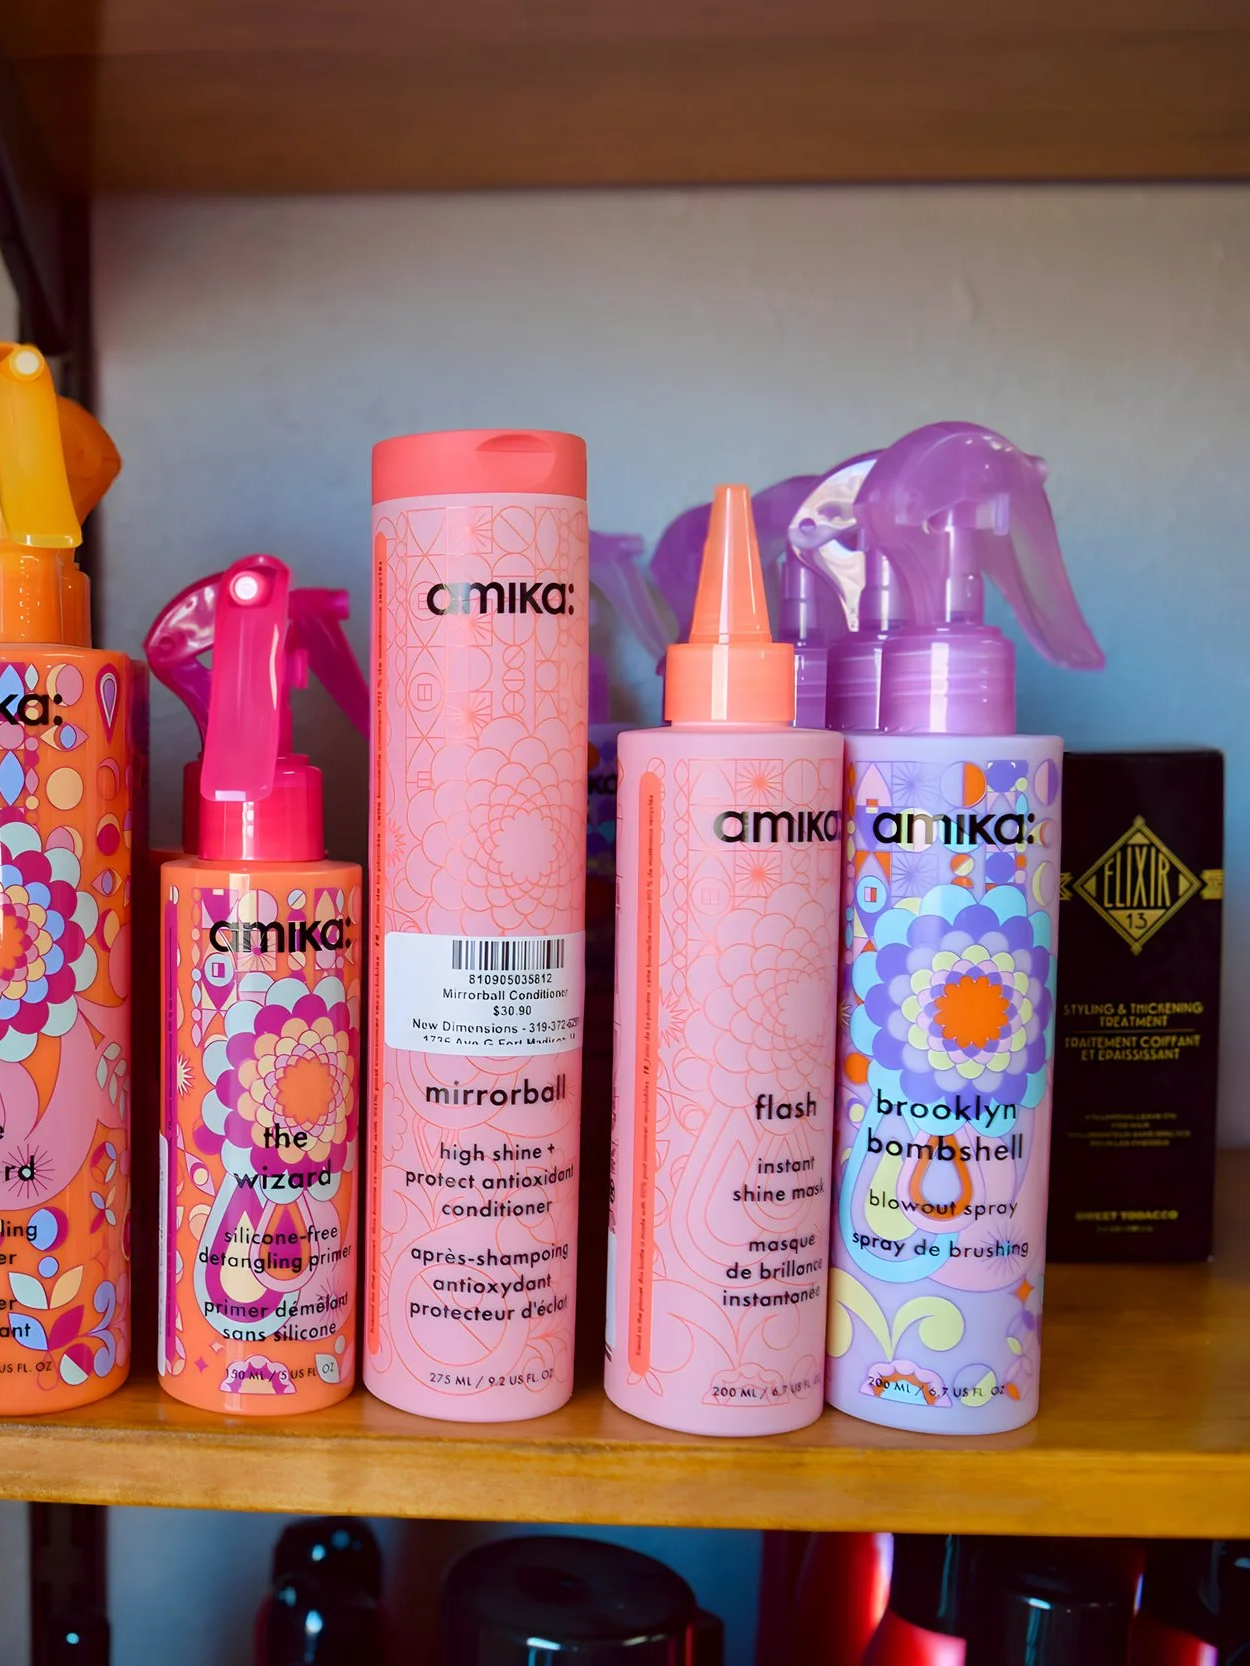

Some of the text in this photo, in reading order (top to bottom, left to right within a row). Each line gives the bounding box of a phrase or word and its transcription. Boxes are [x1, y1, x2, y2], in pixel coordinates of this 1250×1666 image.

[873, 812, 1035, 845] amika:
[1104, 846, 1171, 907] ELIXIR
[1126, 912, 1148, 929] 13
[469, 973, 552, 985] 810905035812
[443, 988, 505, 1001] Mirrorball
[493, 1005, 532, 1017] $30.90
[1063, 1001, 1204, 1015] STYLING & THICKENING
[412, 1018, 438, 1031] New
[442, 1021, 518, 1034] Dimensions
[1099, 1016, 1169, 1028] TREATMENT
[1065, 1034, 1201, 1048] TRAITEMENT COIFFANT
[425, 1073, 567, 1106] mirrorball
[755, 1091, 817, 1120] flash
[877, 1089, 1016, 1128] brooklyn
[263, 1123, 308, 1149] the
[867, 1128, 1022, 1162] bombshell
[440, 1143, 485, 1166] high
[493, 1142, 542, 1162] shine
[758, 1156, 815, 1174] instant
[234, 1160, 331, 1190] wizard
[405, 1163, 574, 1190] protect antioxidant
[733, 1179, 825, 1202] shine mask
[442, 1199, 553, 1217] conditioner
[869, 1189, 1018, 1220] blowout spray
[224, 1225, 338, 1244] silicone-free
[749, 1234, 816, 1254] masque
[852, 1231, 1029, 1258] spray de brushing
[199, 1245, 352, 1274] detangling primer
[411, 1243, 569, 1268] après-shampoing
[726, 1258, 823, 1280] de brillance
[433, 1273, 552, 1299] antioxydant
[204, 1292, 348, 1318] primer démêlant
[410, 1296, 568, 1321] protecteur d'éclat
[223, 1322, 337, 1342] sans silicone
[35, 1361, 52, 1372] OZ
[291, 1367, 304, 1379] US
[430, 1372, 451, 1385] 275
[455, 1376, 472, 1386] ML
[509, 1374, 524, 1385] US
[868, 1376, 890, 1389] 200
[894, 1382, 910, 1393] ML
[953, 1387, 968, 1398] US
[713, 1386, 736, 1397] 200
[740, 1388, 757, 1398] ML
